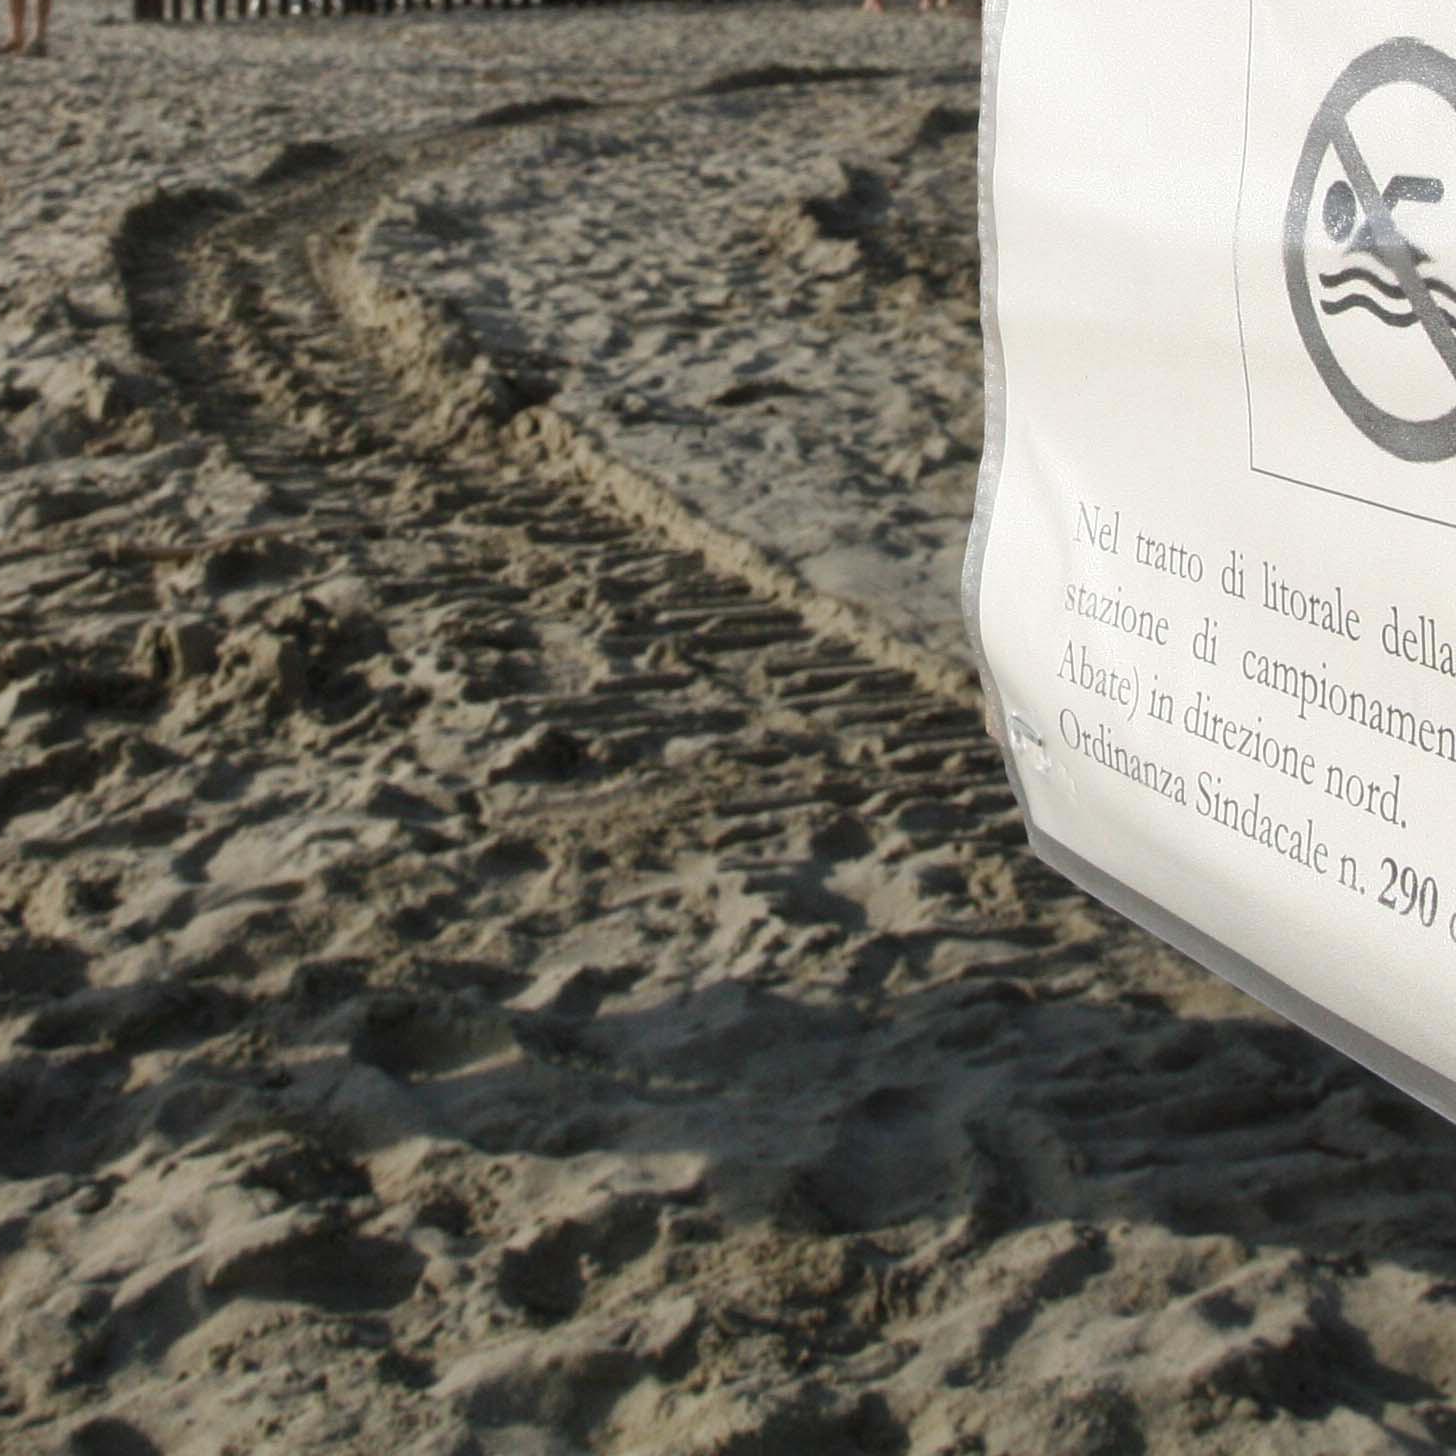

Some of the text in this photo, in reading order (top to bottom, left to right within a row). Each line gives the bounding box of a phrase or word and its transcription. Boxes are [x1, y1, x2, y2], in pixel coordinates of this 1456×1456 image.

[1064, 580, 1169, 645] stazione
[1191, 615, 1219, 668] di
[1070, 501, 1119, 556] Nel
[1135, 527, 1205, 586] tratto
[1219, 550, 1247, 601] di
[1262, 560, 1362, 643] litorale
[1056, 640, 1409, 831] Abate) in direzione nord.
[1056, 707, 1188, 809] Ordinanza
[1194, 772, 1329, 877] Sindacale
[1338, 849, 1367, 896] n.
[1376, 856, 1440, 930] 290
